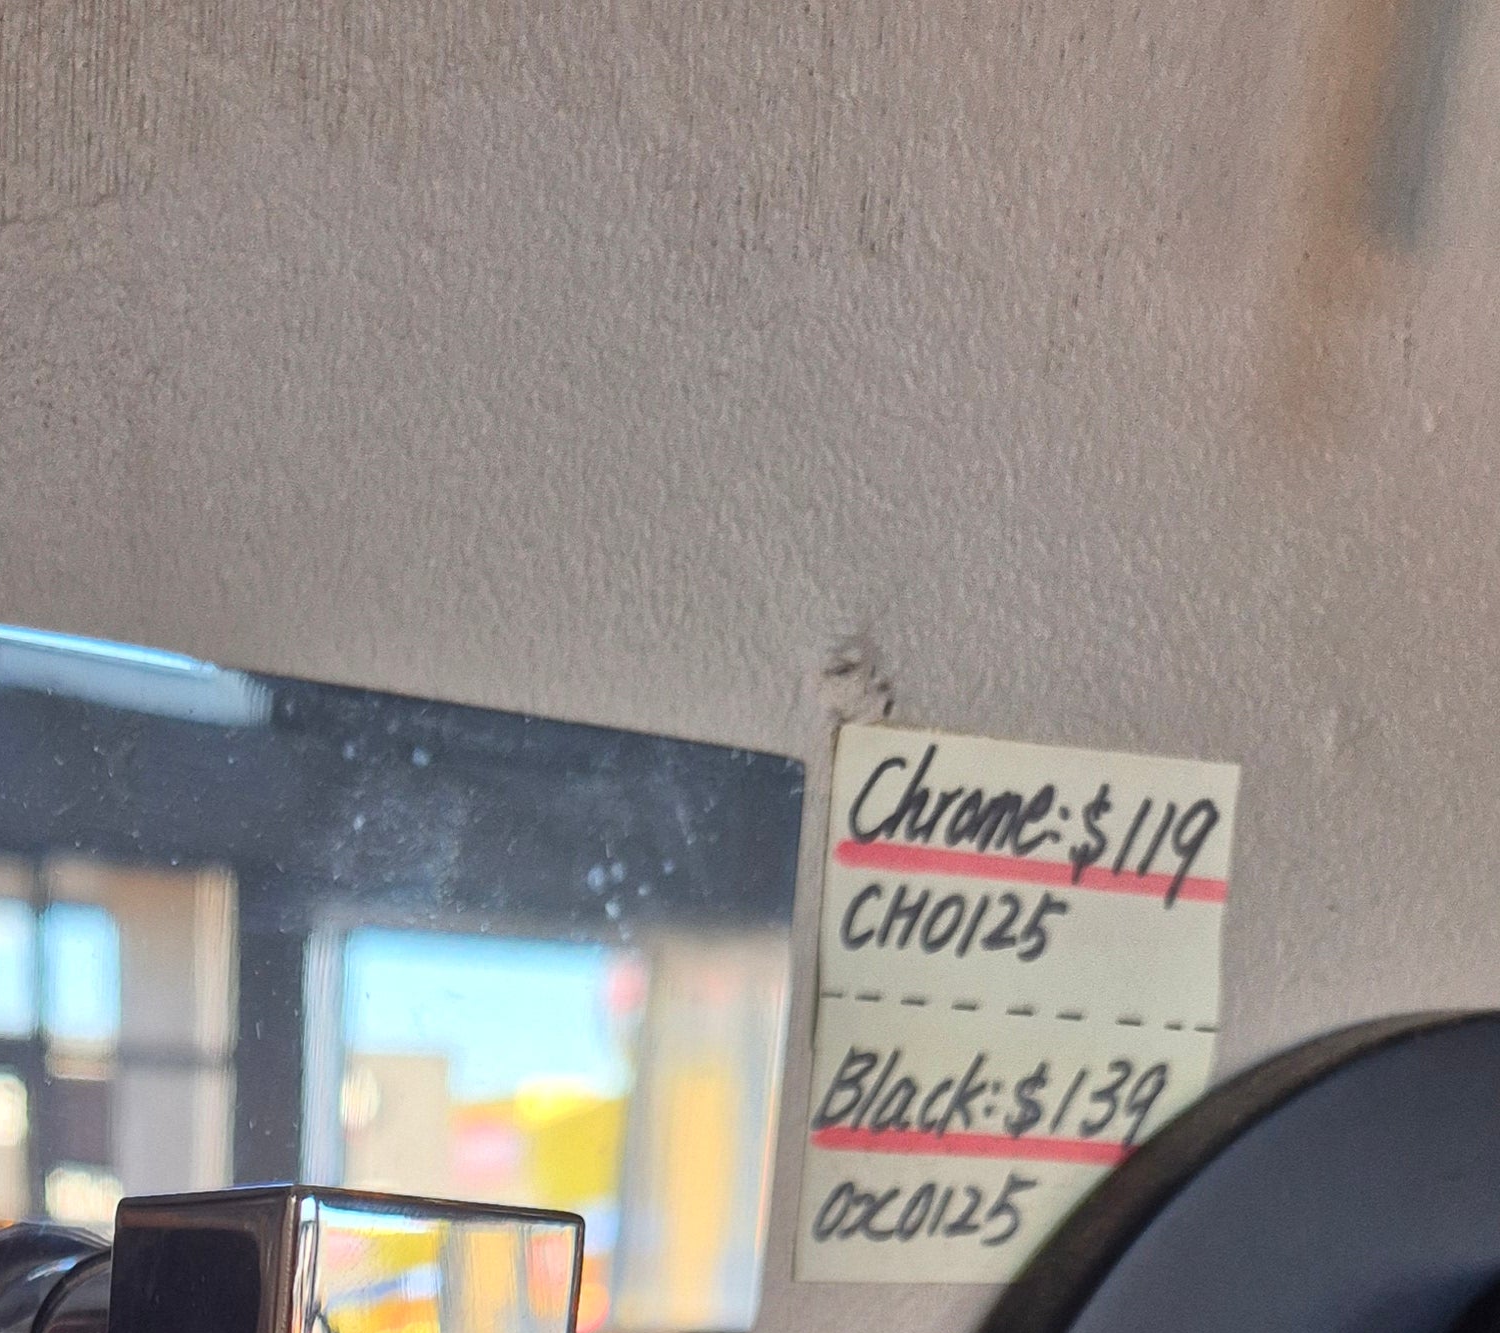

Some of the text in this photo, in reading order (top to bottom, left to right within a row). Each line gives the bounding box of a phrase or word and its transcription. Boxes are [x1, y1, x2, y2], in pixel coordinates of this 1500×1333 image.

[1068, 783, 1220, 910] $119
[839, 884, 1068, 963] CH0125
[1003, 1060, 1169, 1152] $139
